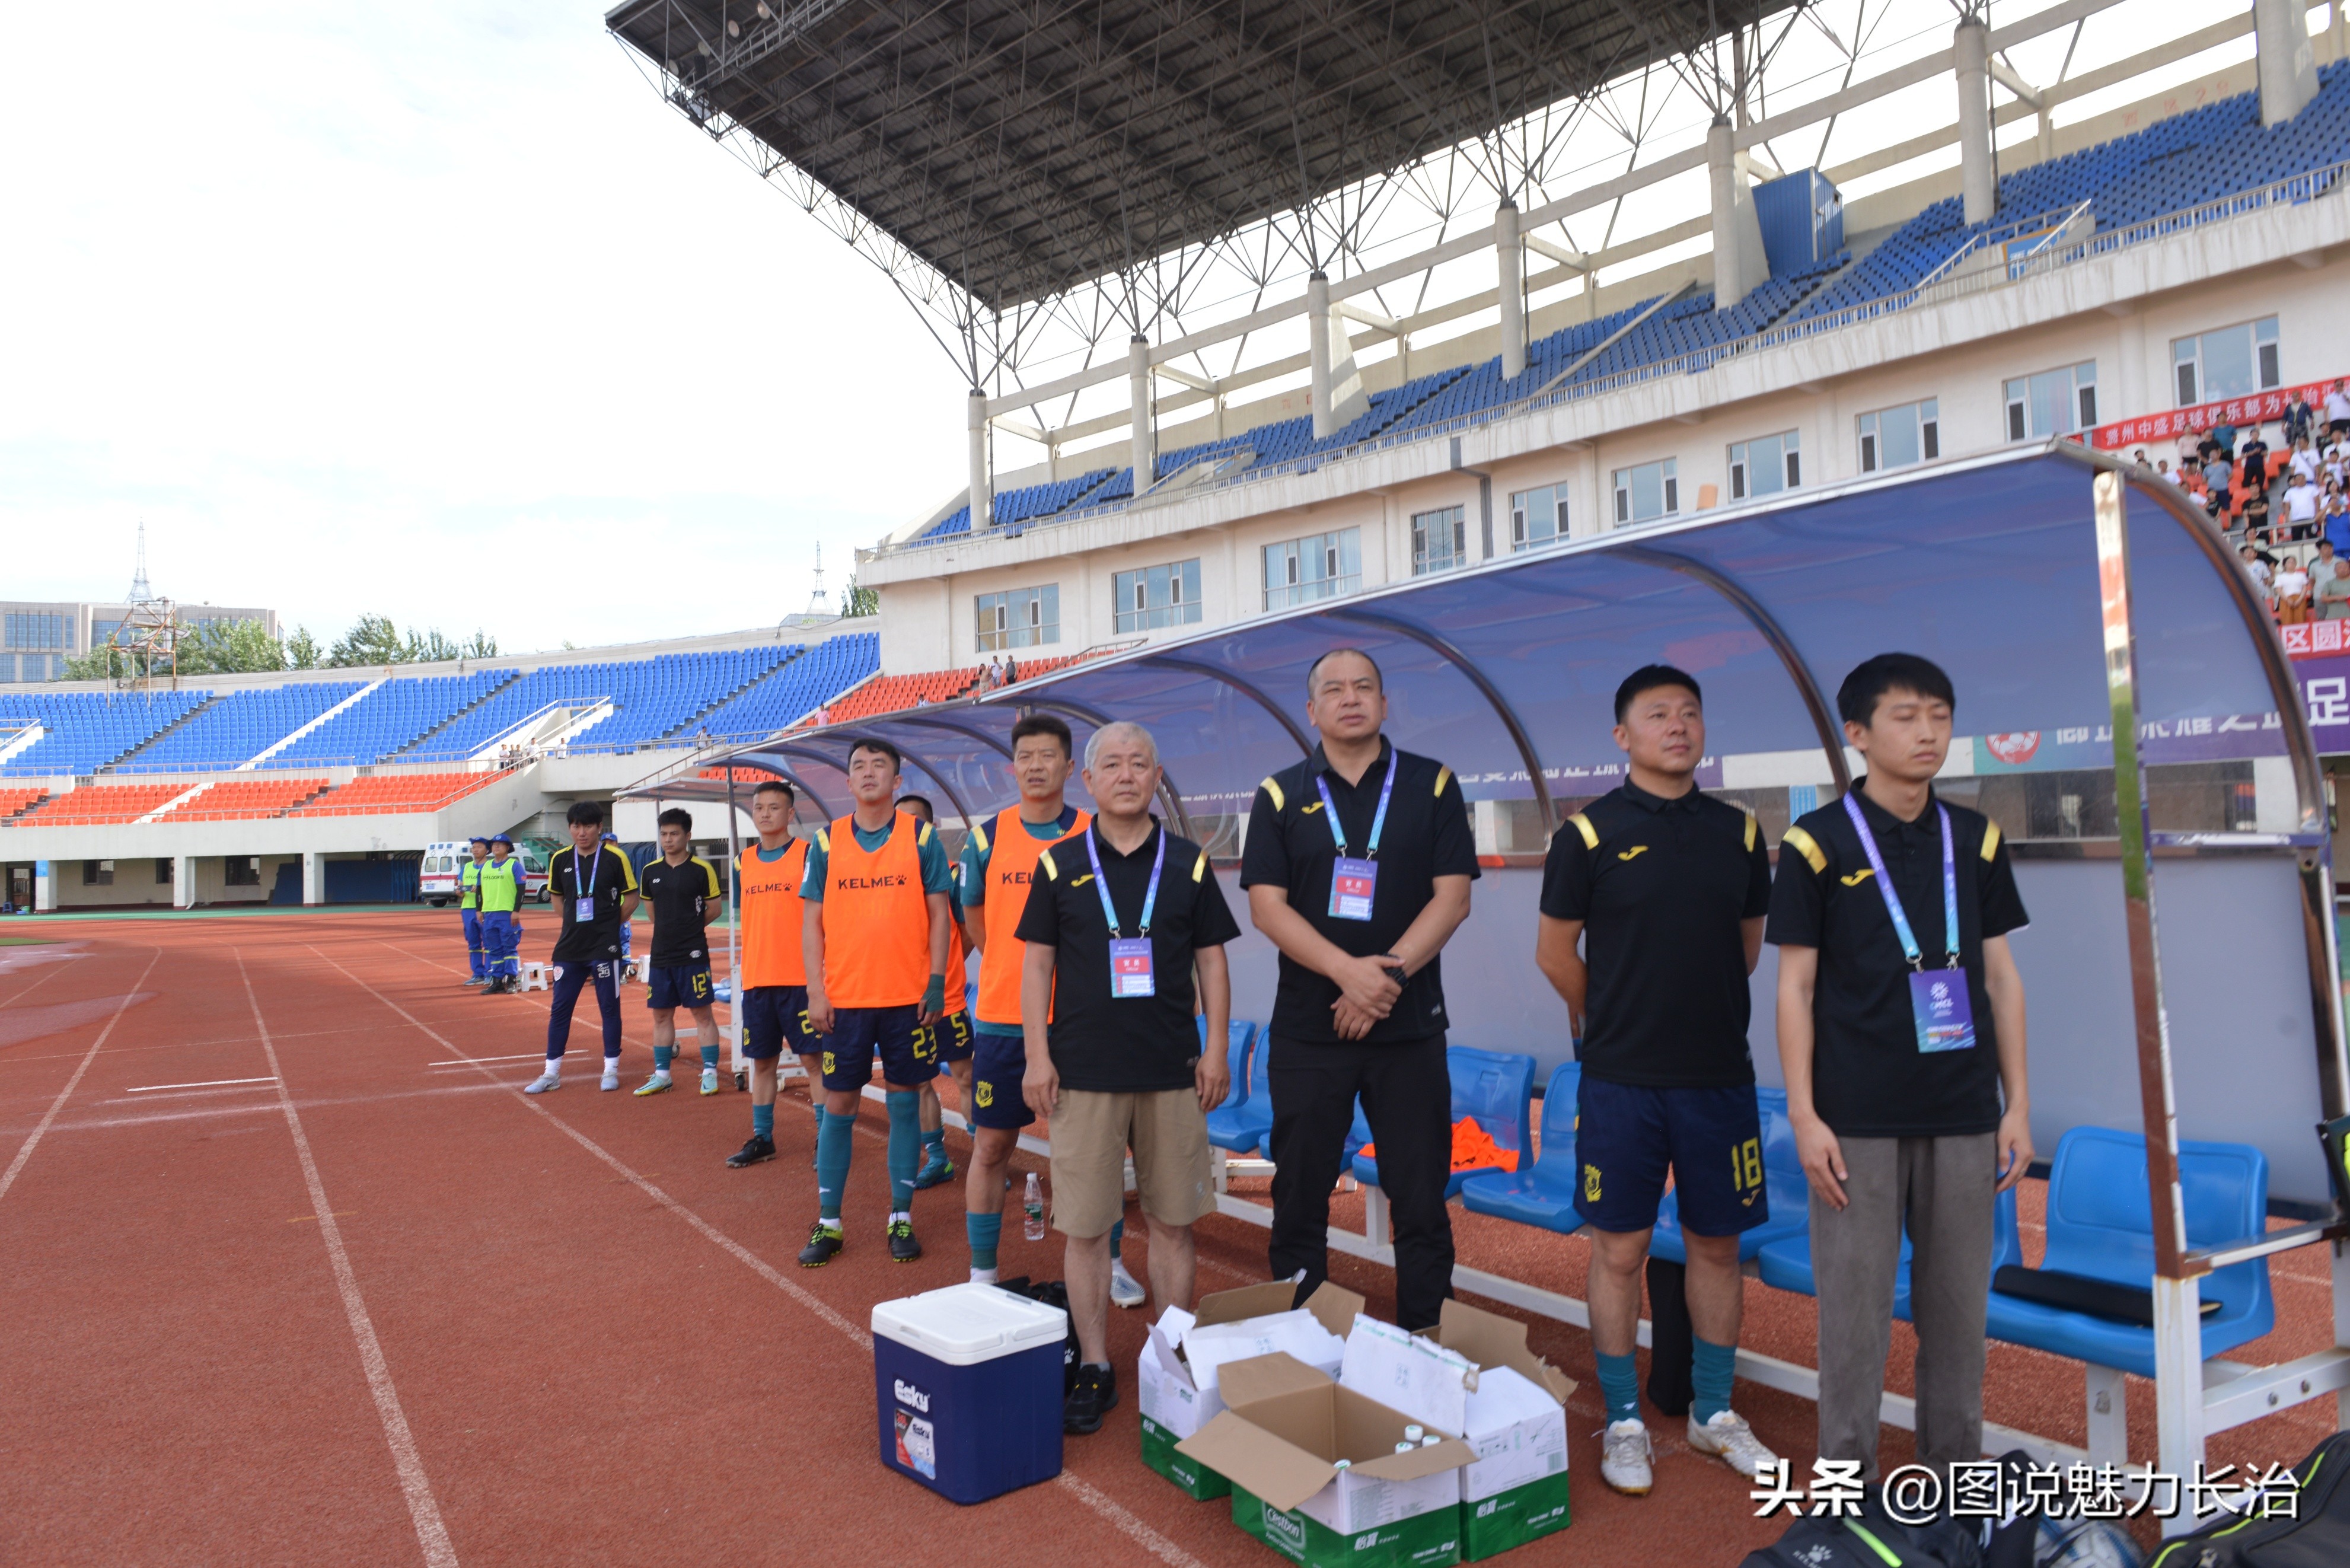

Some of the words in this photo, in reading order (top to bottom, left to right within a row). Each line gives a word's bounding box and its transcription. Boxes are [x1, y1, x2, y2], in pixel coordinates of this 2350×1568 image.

[2282, 619, 2350, 654] 区圆
[2307, 677, 2349, 727] 足
[745, 883, 782, 896] KELME
[838, 876, 894, 890] KELME
[1002, 872, 1032, 884] KEL
[598, 968, 610, 978] 29
[693, 973, 707, 993] 12
[951, 1012, 967, 1038] 5
[911, 1025, 937, 1059] 23
[1732, 1137, 1762, 1192] 18
[894, 1379, 929, 1413] Esky
